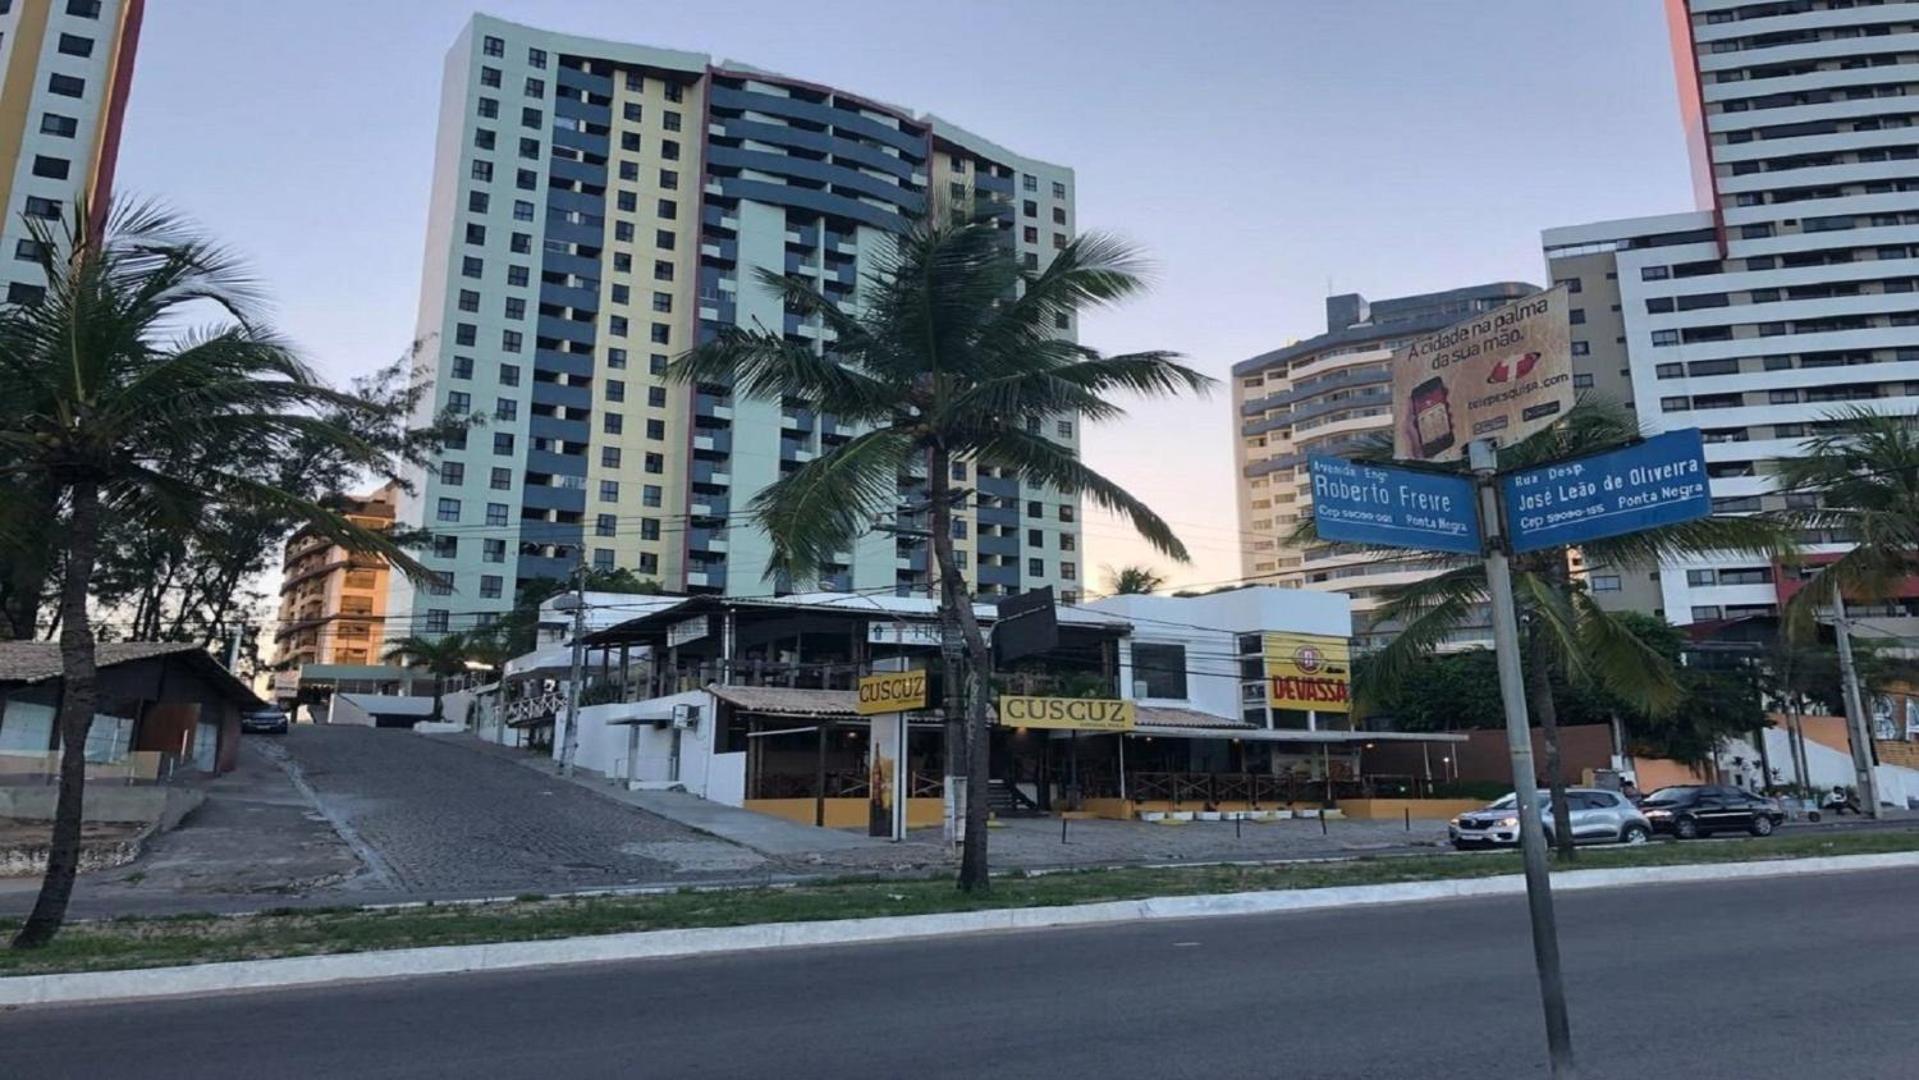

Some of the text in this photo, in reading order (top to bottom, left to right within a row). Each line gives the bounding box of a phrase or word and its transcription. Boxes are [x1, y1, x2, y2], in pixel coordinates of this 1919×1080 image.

[1408, 299, 1549, 361] A cidade na palma
[1432, 328, 1525, 371] da sua mão.
[1314, 460, 1356, 478] Avenida
[1515, 475, 1538, 487] Rua
[1314, 474, 1452, 513] Roberto Freire
[1519, 459, 1698, 512] José Leão de Oliveira
[1318, 504, 1340, 518] Cep
[1405, 513, 1437, 529] Ponta
[1438, 516, 1468, 534] Negra
[1520, 516, 1544, 530] Cep
[1618, 492, 1658, 509] Ponta
[1661, 483, 1704, 501] Negra
[859, 675, 925, 703] CUSCUZ
[1271, 674, 1349, 703] DEVASSA
[1006, 699, 1126, 722] CUSCUZ
